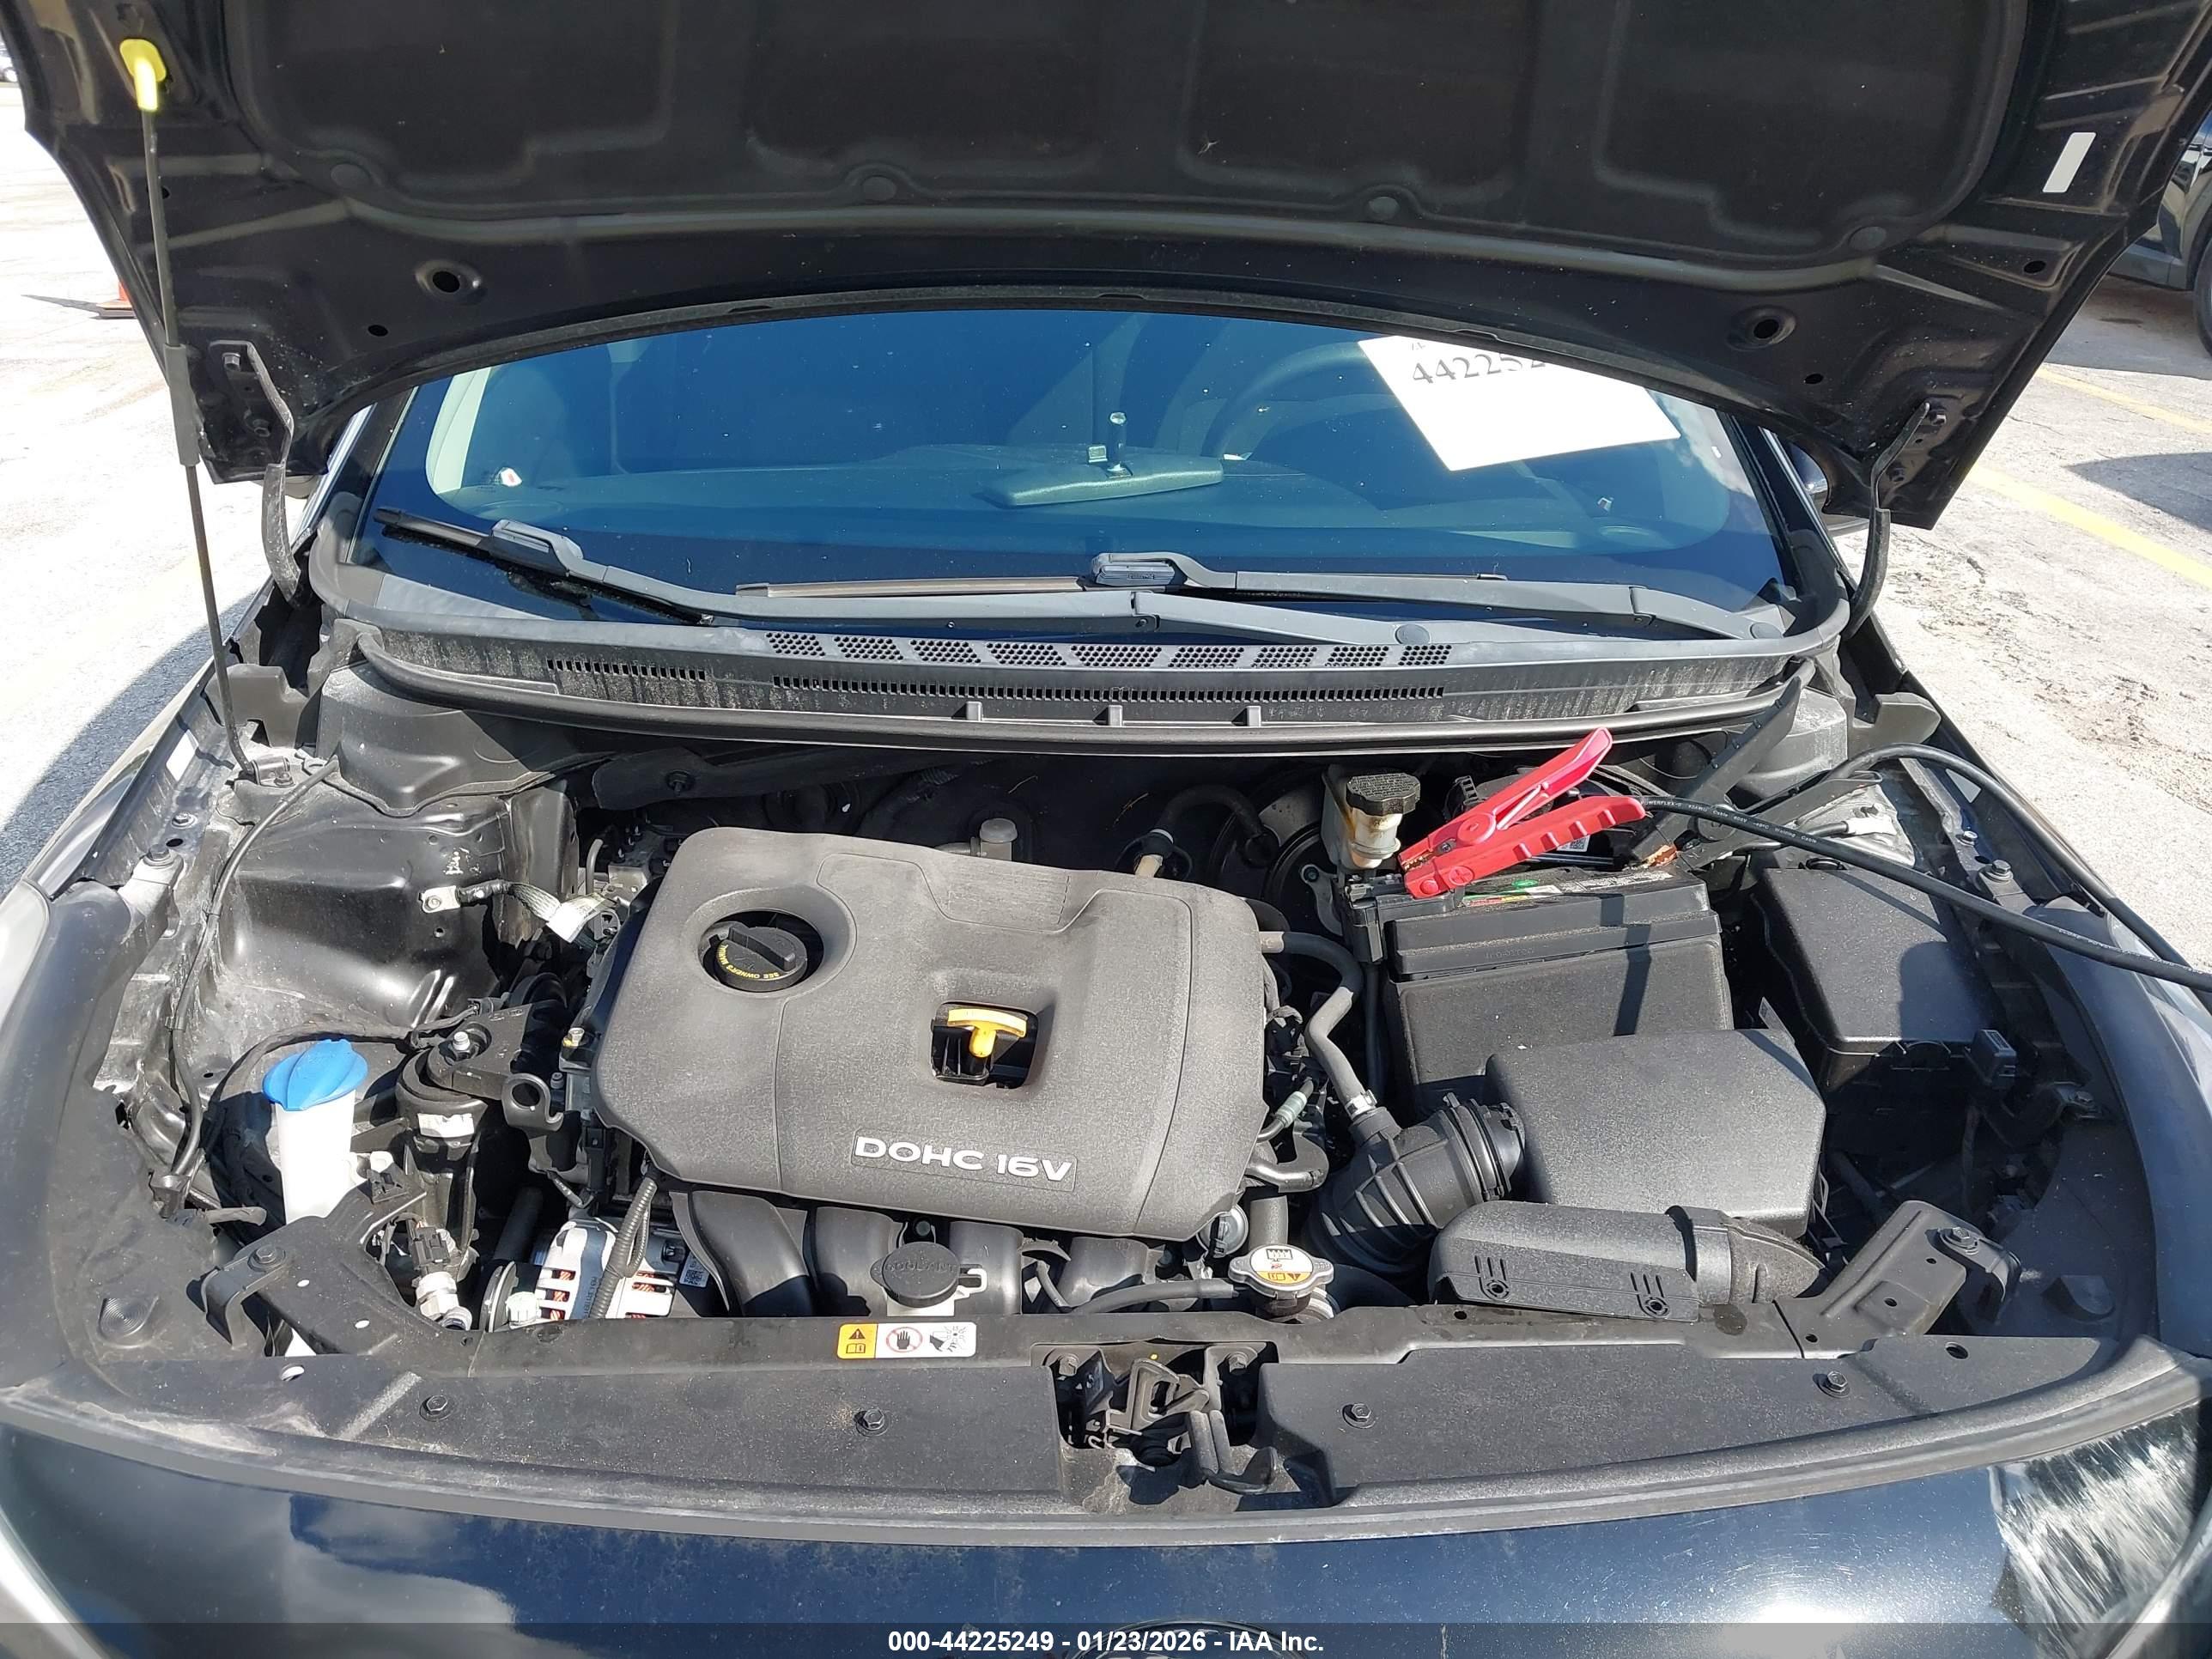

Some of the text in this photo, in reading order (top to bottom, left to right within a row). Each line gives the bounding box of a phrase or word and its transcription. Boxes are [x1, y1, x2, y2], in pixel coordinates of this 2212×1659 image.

[726, 963, 761, 980] OWNER'S
[763, 971, 781, 980] SEE
[854, 1136, 1073, 1182] DOHC 16V
